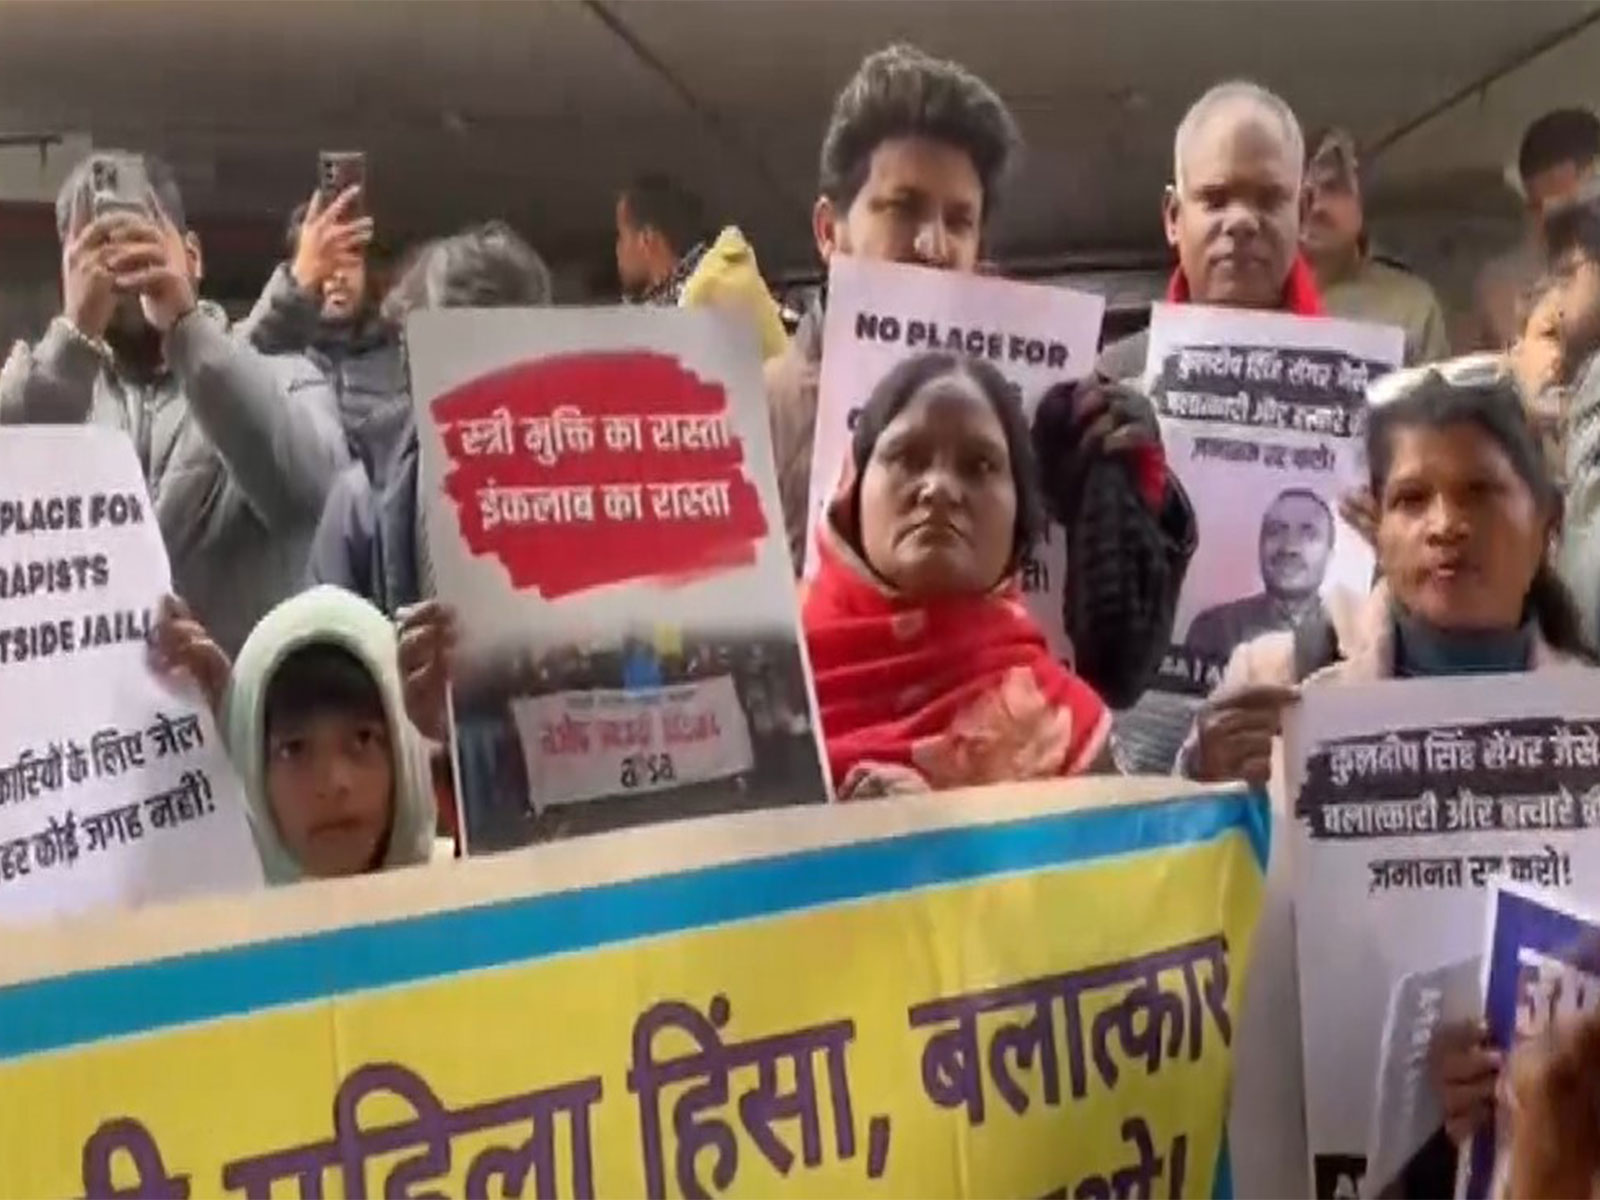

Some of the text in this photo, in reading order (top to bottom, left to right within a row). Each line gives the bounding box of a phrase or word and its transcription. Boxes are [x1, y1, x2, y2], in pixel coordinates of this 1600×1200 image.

[856, 312, 1069, 369] NO PLACE FOR
[459, 406, 731, 465] स्त्री मुक्ति का रास्ता
[0, 496, 82, 536] PLACE
[477, 478, 731, 531] इंकलाब का रास्ता
[66, 740, 88, 783] के
[92, 729, 145, 776] लिए
[146, 713, 204, 757] जेल
[1329, 733, 1420, 786] कुलदीप
[1424, 730, 1477, 771] सिंह
[33, 810, 79, 866] कोई
[81, 804, 143, 850] जगह
[1323, 790, 1438, 834] बलात्कारी
[1446, 788, 1494, 829] और
[627, 994, 890, 1200] हिंसा,
[909, 934, 1232, 1126] बलात्कार
